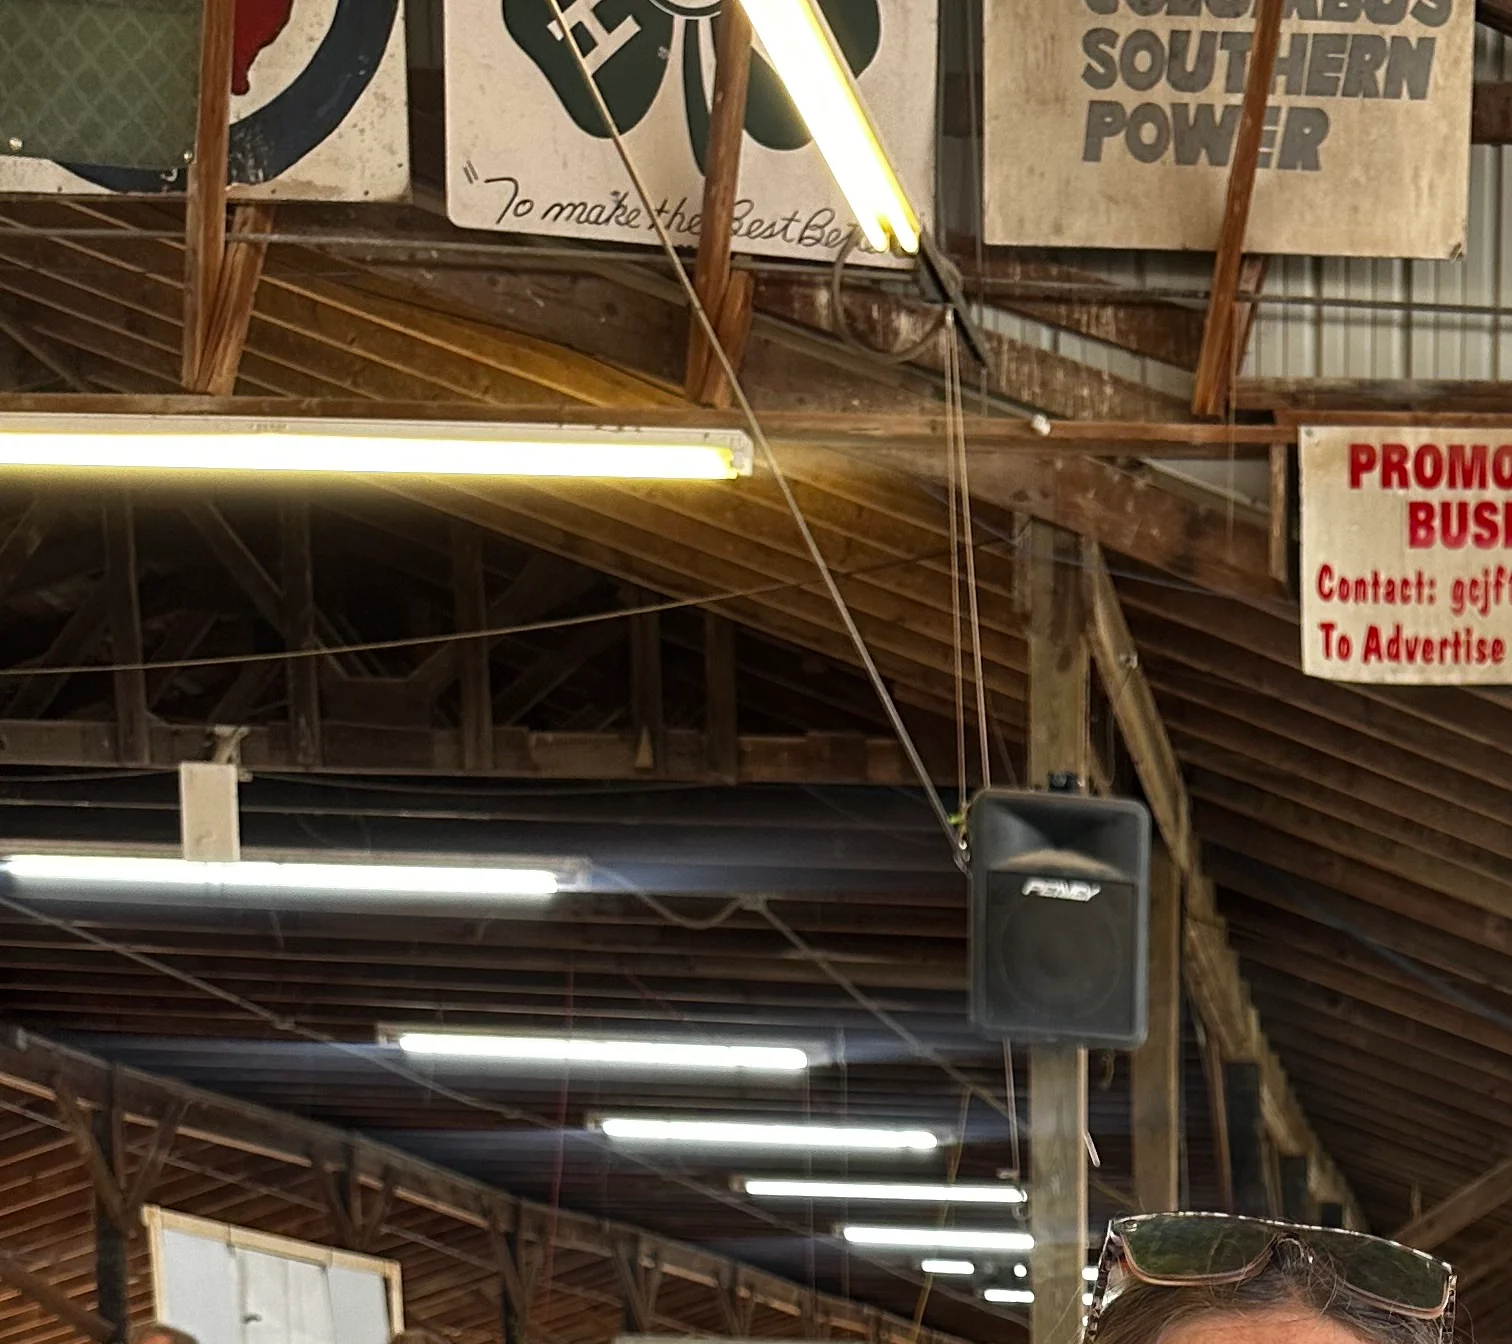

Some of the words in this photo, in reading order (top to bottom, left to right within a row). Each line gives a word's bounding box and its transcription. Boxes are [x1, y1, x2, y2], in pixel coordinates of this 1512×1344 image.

[1081, 27, 1437, 100] SOUTHERN
[542, 190, 641, 229] make
[1317, 564, 1437, 603] Contact:
[1318, 622, 1352, 661] To
[1362, 624, 1504, 664] Advertise
